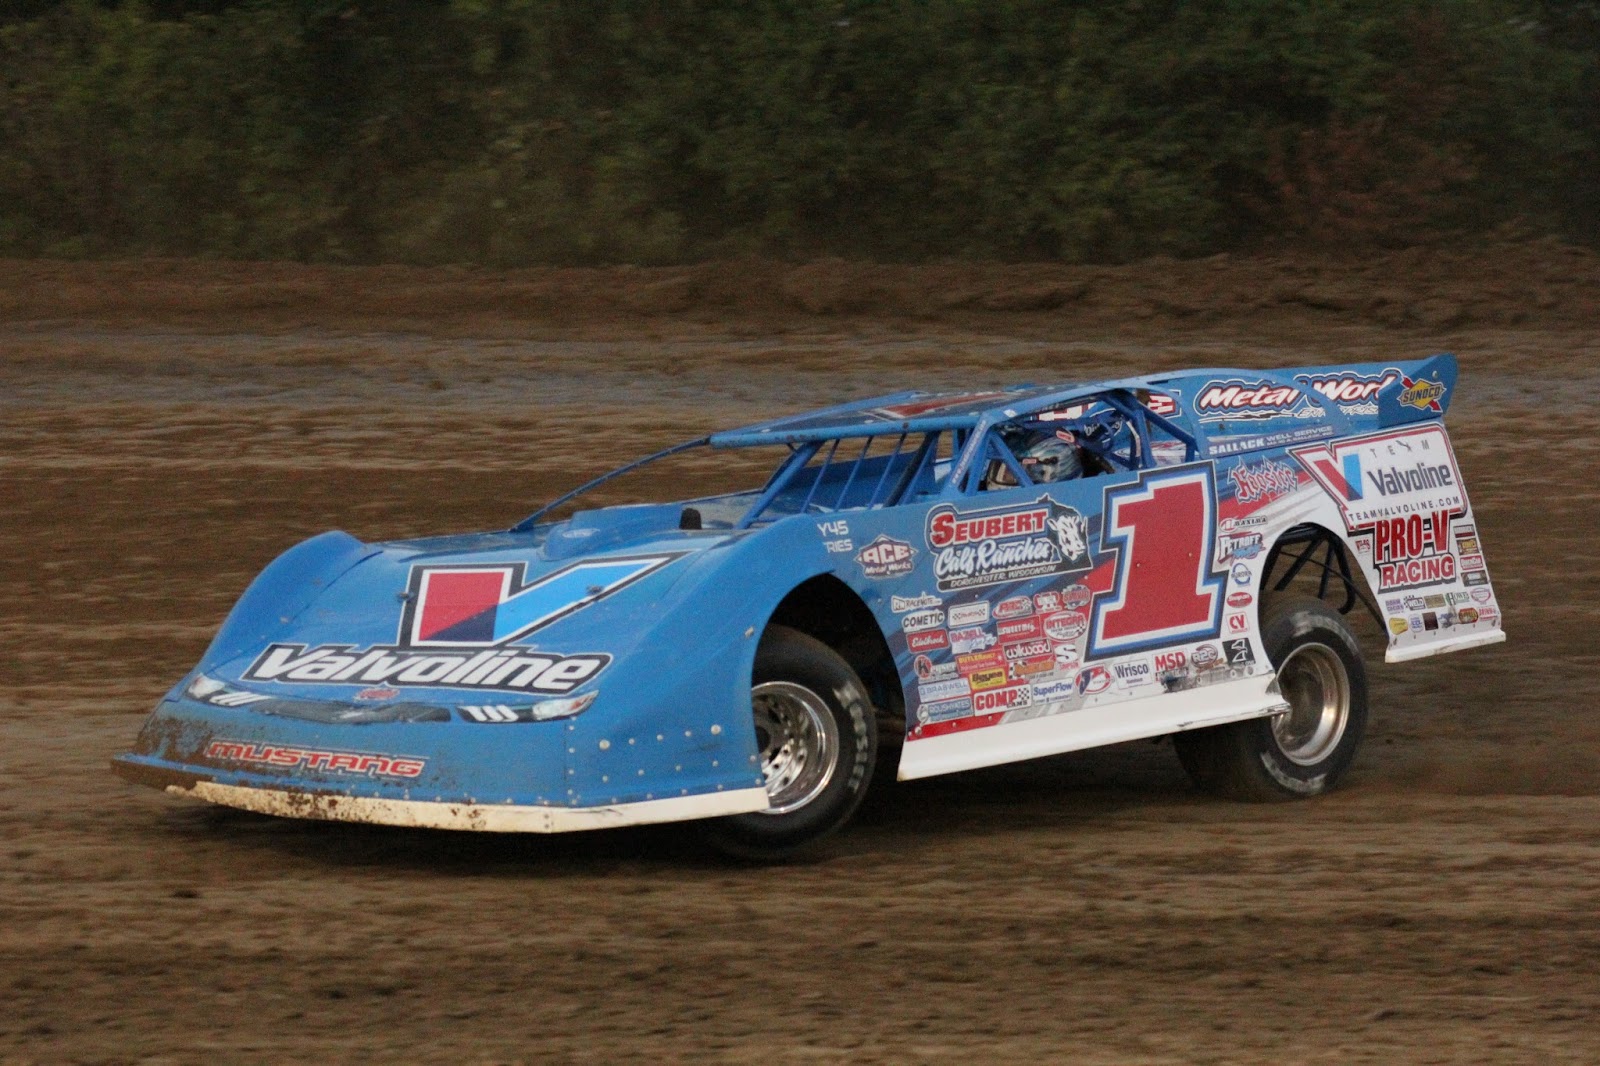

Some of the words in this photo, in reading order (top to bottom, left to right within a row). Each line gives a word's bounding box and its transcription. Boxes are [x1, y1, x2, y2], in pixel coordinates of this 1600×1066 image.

[1403, 384, 1442, 403] SUNOCO
[1208, 438, 1265, 455] SALLACK
[1266, 432, 1292, 442] WELL
[1294, 425, 1333, 437] SERVICE
[1367, 463, 1453, 496] Valvoline
[1348, 496, 1460, 522] TEAMVALVOLINE.COM
[930, 510, 1048, 546] SEUBERT
[862, 543, 910, 564] ACE
[1100, 478, 1215, 644] 1
[1008, 564, 1058, 579] WISCONSIN
[1380, 555, 1455, 588] RACING
[903, 612, 944, 628] COMETIC
[1229, 614, 1245, 630] CV
[256, 646, 601, 692] Valvoline
[1114, 663, 1149, 679] Wrisco
[1155, 651, 1186, 671] MSD
[975, 689, 1018, 711] COMP
[1033, 682, 1073, 697] SuperFlow
[206, 740, 426, 779] MUSTANG
